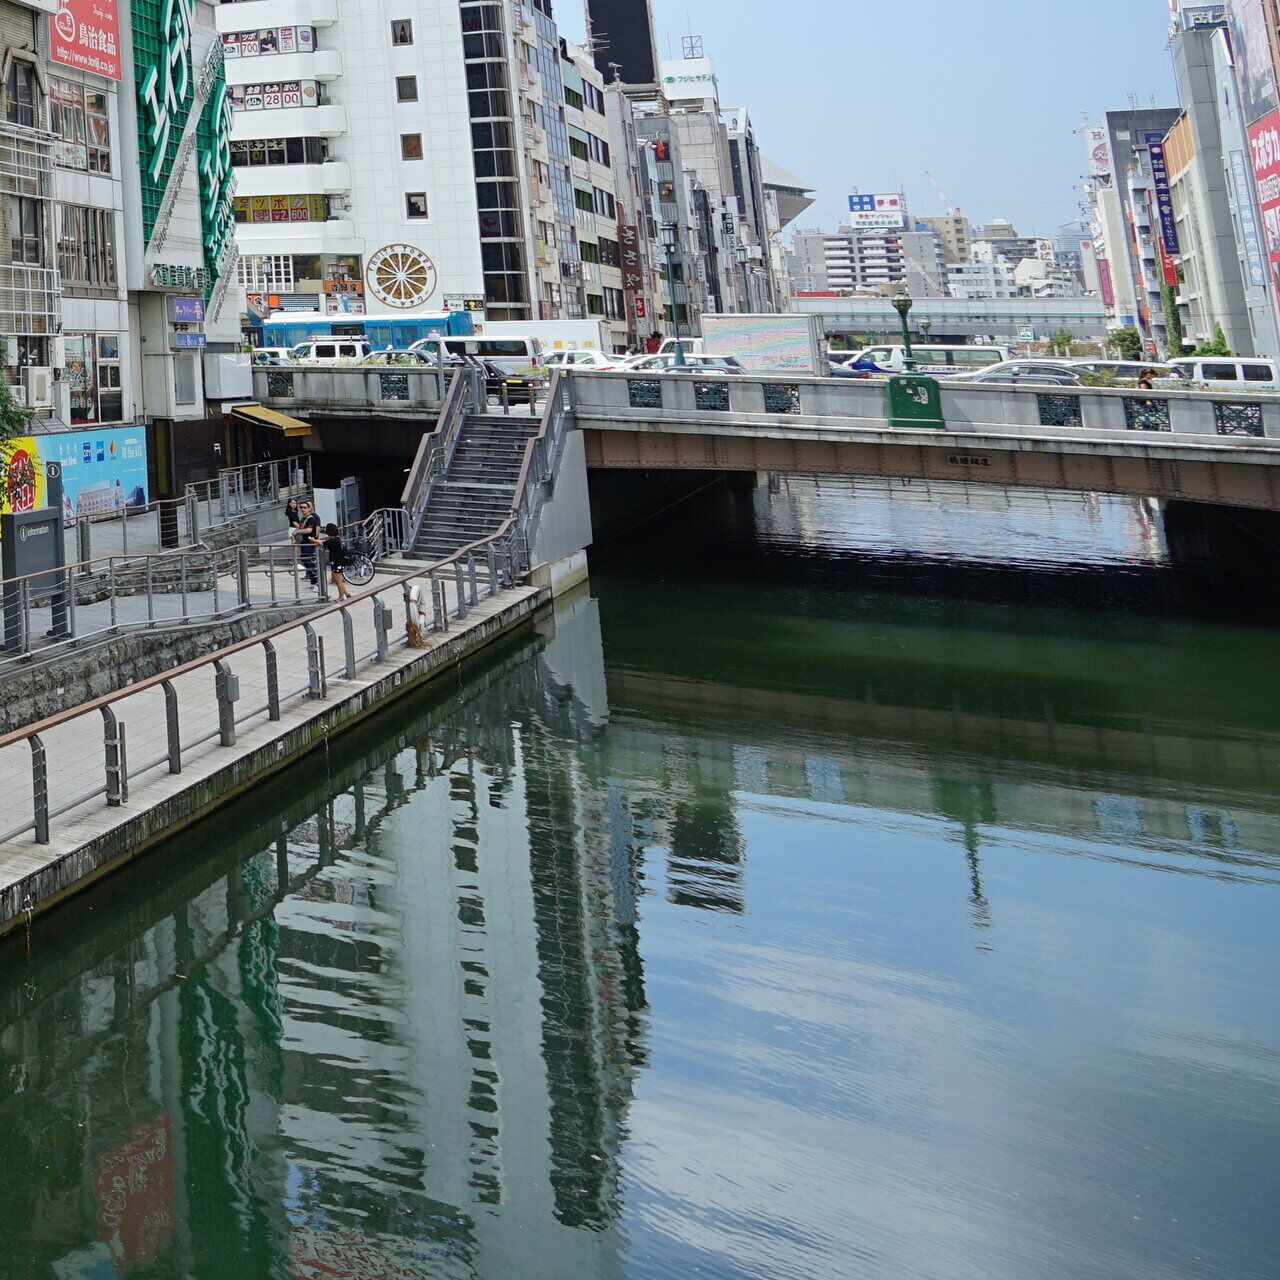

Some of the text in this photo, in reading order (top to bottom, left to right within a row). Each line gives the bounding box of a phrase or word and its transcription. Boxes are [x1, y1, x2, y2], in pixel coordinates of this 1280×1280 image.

[368, 245, 433, 273] FRUITS TOWER
[26, 525, 50, 537] information
